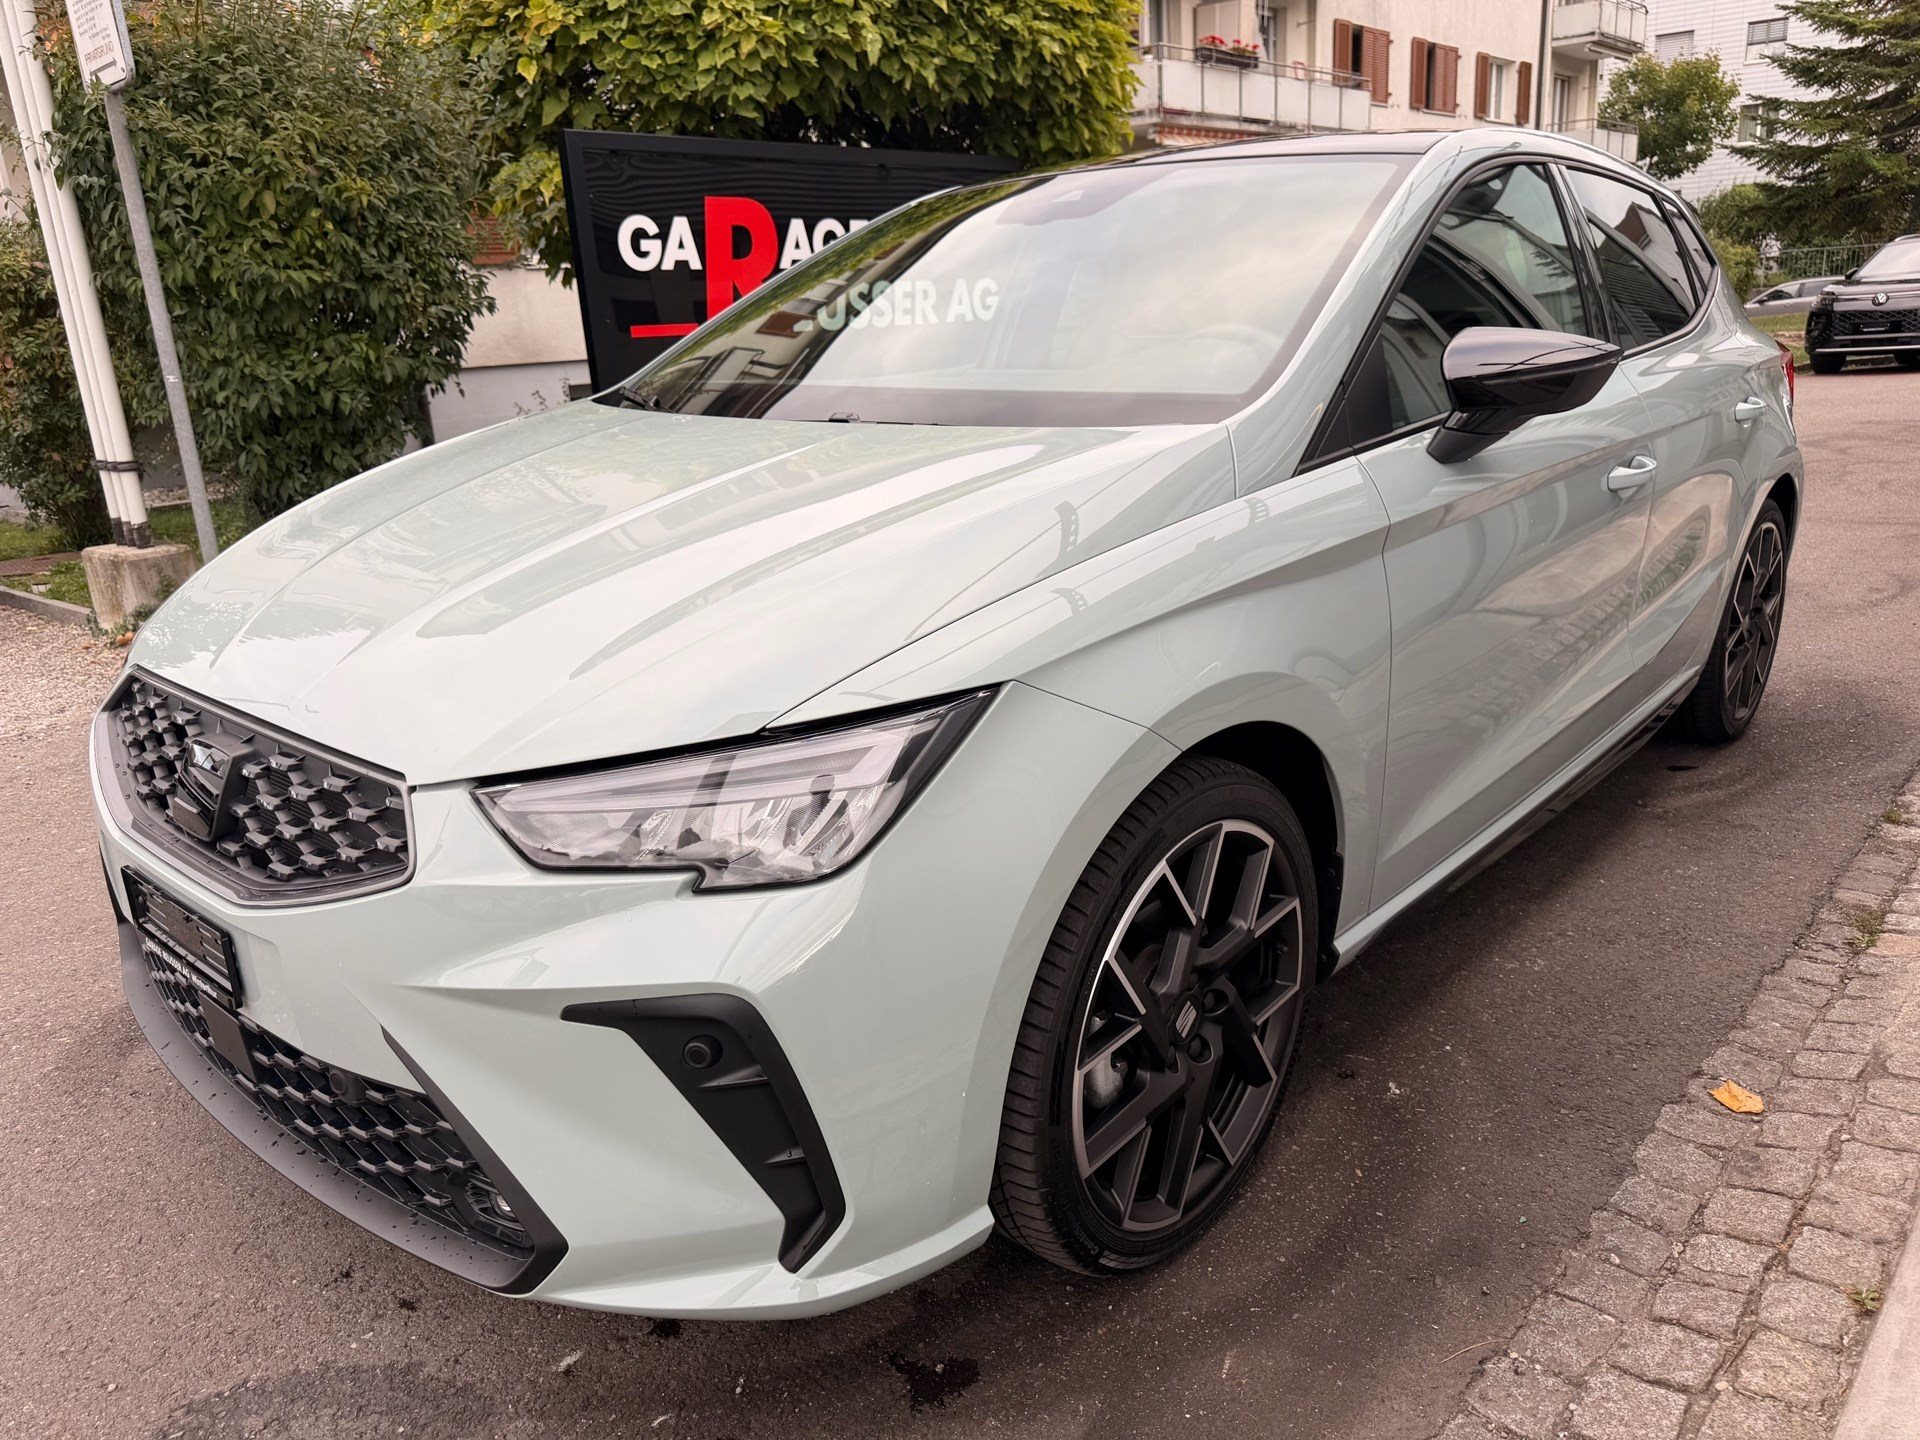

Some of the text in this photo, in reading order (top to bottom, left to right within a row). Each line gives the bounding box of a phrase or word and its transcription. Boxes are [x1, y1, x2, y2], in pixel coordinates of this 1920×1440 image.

[617, 196, 868, 320] GARAG
[793, 277, 1000, 331] USSER AG
